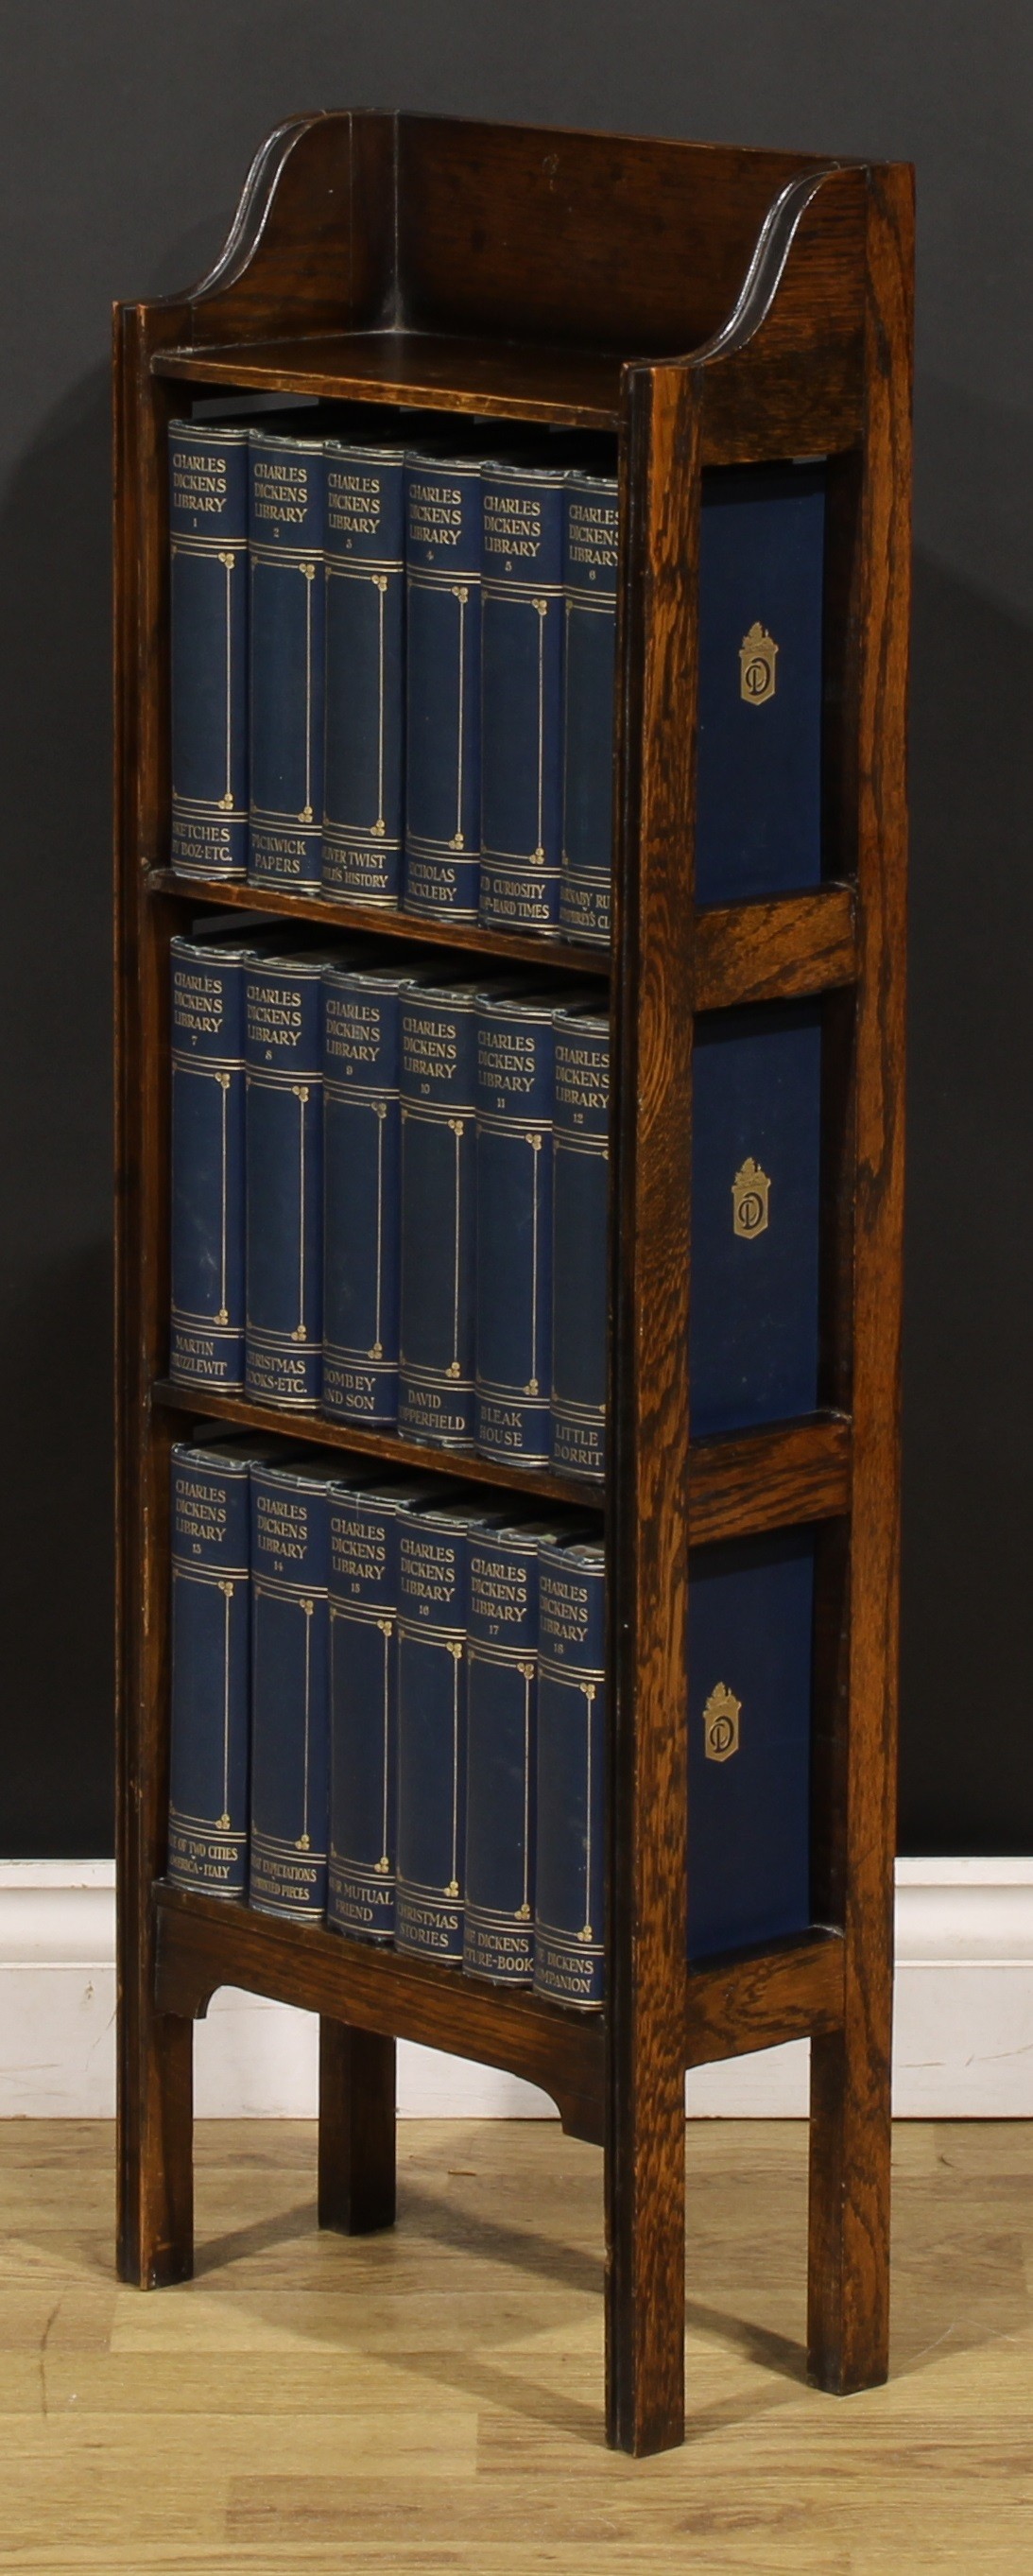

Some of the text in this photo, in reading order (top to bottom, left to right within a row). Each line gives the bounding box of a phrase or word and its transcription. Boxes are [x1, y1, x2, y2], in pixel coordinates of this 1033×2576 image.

[173, 453, 226, 474] CHARLES
[254, 463, 307, 483] CHARLES
[173, 473, 227, 493] DICKENS
[254, 482, 307, 503] DICKENS
[328, 474, 380, 493] CHARLES
[174, 493, 227, 512] LIBRARY
[328, 493, 380, 514] DICKENS
[409, 484, 461, 505] CHARLES
[484, 495, 541, 516] CHARLES
[193, 518, 198, 527] 1
[255, 502, 308, 523] LIBRARY
[329, 513, 380, 534] LIBRARY
[410, 504, 461, 525] DICKENS
[273, 527, 280, 538] 2
[410, 524, 461, 545] LIBRARY
[484, 515, 541, 537] DICKENS
[346, 539, 353, 549] 3
[485, 536, 541, 557] LIBRARY
[426, 550, 434, 561] 4
[505, 561, 512, 572] 5
[589, 570, 595, 580] 6
[252, 834, 306, 856] PICKWICK
[255, 854, 301, 873] PAPERS
[349, 852, 386, 869] TWIST
[345, 872, 388, 888] HISTORY
[493, 879, 545, 899] CURIOSITY
[519, 903, 550, 919] TIMES
[174, 972, 222, 994] CHARLES
[174, 991, 223, 1013] DICKENS
[247, 985, 301, 1007] CHARLES
[174, 1011, 223, 1033] LIBRARY
[248, 1005, 301, 1027] DICKENS
[326, 1000, 380, 1022] CHARLES
[248, 1024, 301, 1046] LIBRARY
[327, 1019, 380, 1042] DICKENS
[403, 1017, 456, 1039] CHARLES
[192, 1035, 198, 1046] 7
[327, 1039, 380, 1062] LIBRARY
[404, 1037, 456, 1060] DICKENS
[478, 1030, 535, 1052] CHARLES
[265, 1049, 272, 1060] 8
[478, 1050, 535, 1073] DICKENS
[555, 1046, 610, 1068] CHARLES
[346, 1065, 353, 1075] 9
[404, 1056, 456, 1079] LIBRARY
[556, 1065, 610, 1088] DICKENS
[421, 1083, 430, 1094] 10
[478, 1070, 535, 1092] LIBRARY
[497, 1098, 506, 1108] 11
[556, 1085, 610, 1109] LIBRARY
[573, 1113, 584, 1124] 12
[176, 1335, 214, 1356] MARTIN
[346, 1394, 375, 1410] SON
[408, 1390, 441, 1409] DAVID
[481, 1406, 523, 1427] BLEAK
[479, 1425, 523, 1447] HOUSE
[556, 1424, 598, 1446] LITTLE
[554, 1443, 603, 1465] DORRIT
[176, 1479, 226, 1503] CHARLES
[176, 1498, 226, 1523] DICKENS
[257, 1496, 307, 1520] CHARLES
[176, 1517, 226, 1542] LIBRARY
[257, 1515, 307, 1540] DICKENS
[331, 1517, 385, 1542] CHARLES
[258, 1534, 308, 1559] LIBRARY
[332, 1536, 386, 1561] DICKENS
[400, 1538, 455, 1563] CHARLES
[332, 1556, 386, 1581] LIBRARY
[401, 1557, 456, 1582] DICKENS
[472, 1558, 526, 1582] CHARLES
[401, 1577, 456, 1602] LIBRARY
[472, 1576, 526, 1602] DICKENS
[540, 1576, 588, 1602] CHARLES
[472, 1597, 527, 1622] LIBRARY
[540, 1596, 588, 1623] DICKENS
[490, 1625, 499, 1635] 17
[540, 1615, 589, 1642] LIBRARY
[189, 1841, 206, 1857] TWO
[208, 1845, 238, 1861] CITIES
[282, 1884, 310, 1900] PIECES
[344, 1883, 393, 1905] MUTUAL
[336, 1898, 372, 1922] FRIEND
[400, 1925, 449, 1947] STORIES
[478, 1932, 529, 1953] DICKENS
[547, 1951, 594, 1975] DICKENS
